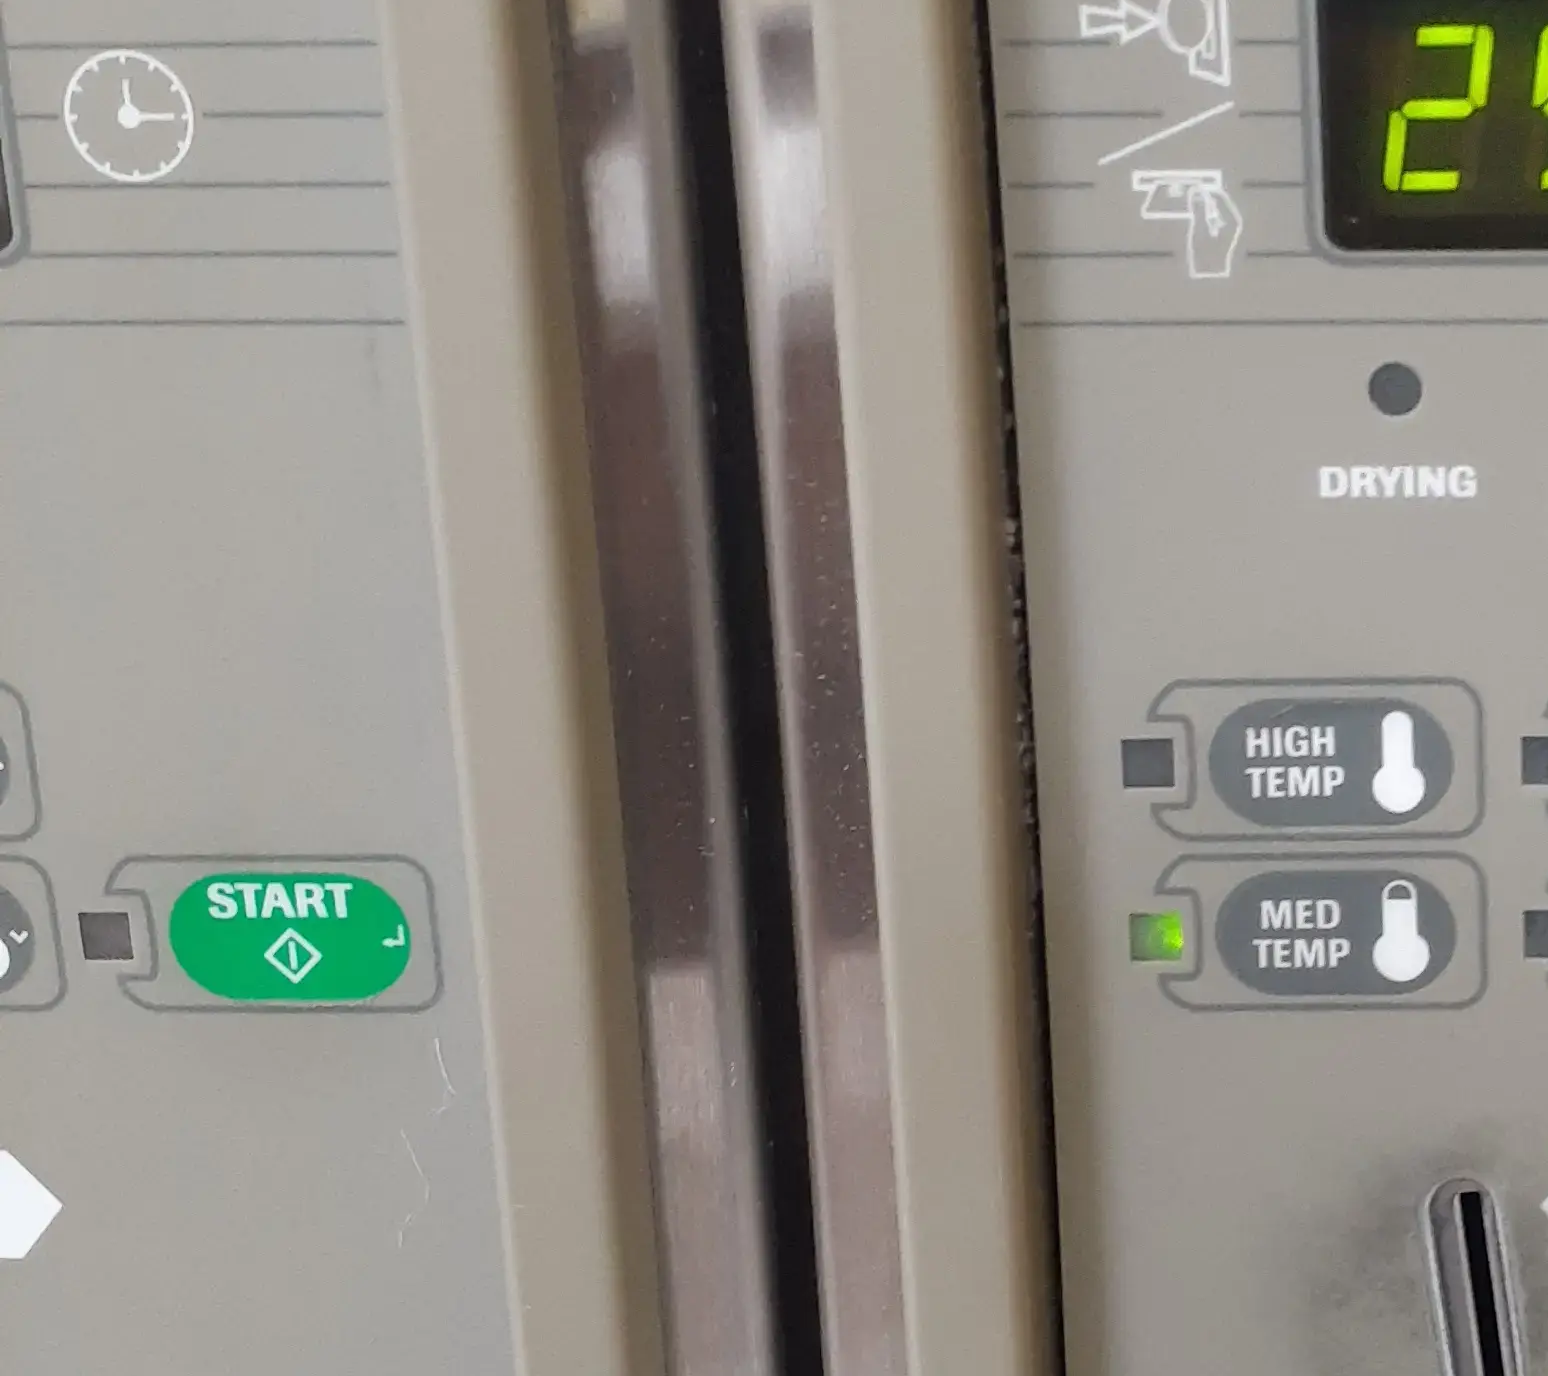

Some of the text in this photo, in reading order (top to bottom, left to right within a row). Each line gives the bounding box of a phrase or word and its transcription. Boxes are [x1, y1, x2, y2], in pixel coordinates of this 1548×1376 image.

[1318, 465, 1478, 499] DRYING
[1245, 725, 1336, 758] HIGH
[1244, 765, 1346, 799] TEMP
[206, 881, 353, 920] START
[1259, 898, 1341, 930] MED
[1252, 937, 1351, 969] TEMP
